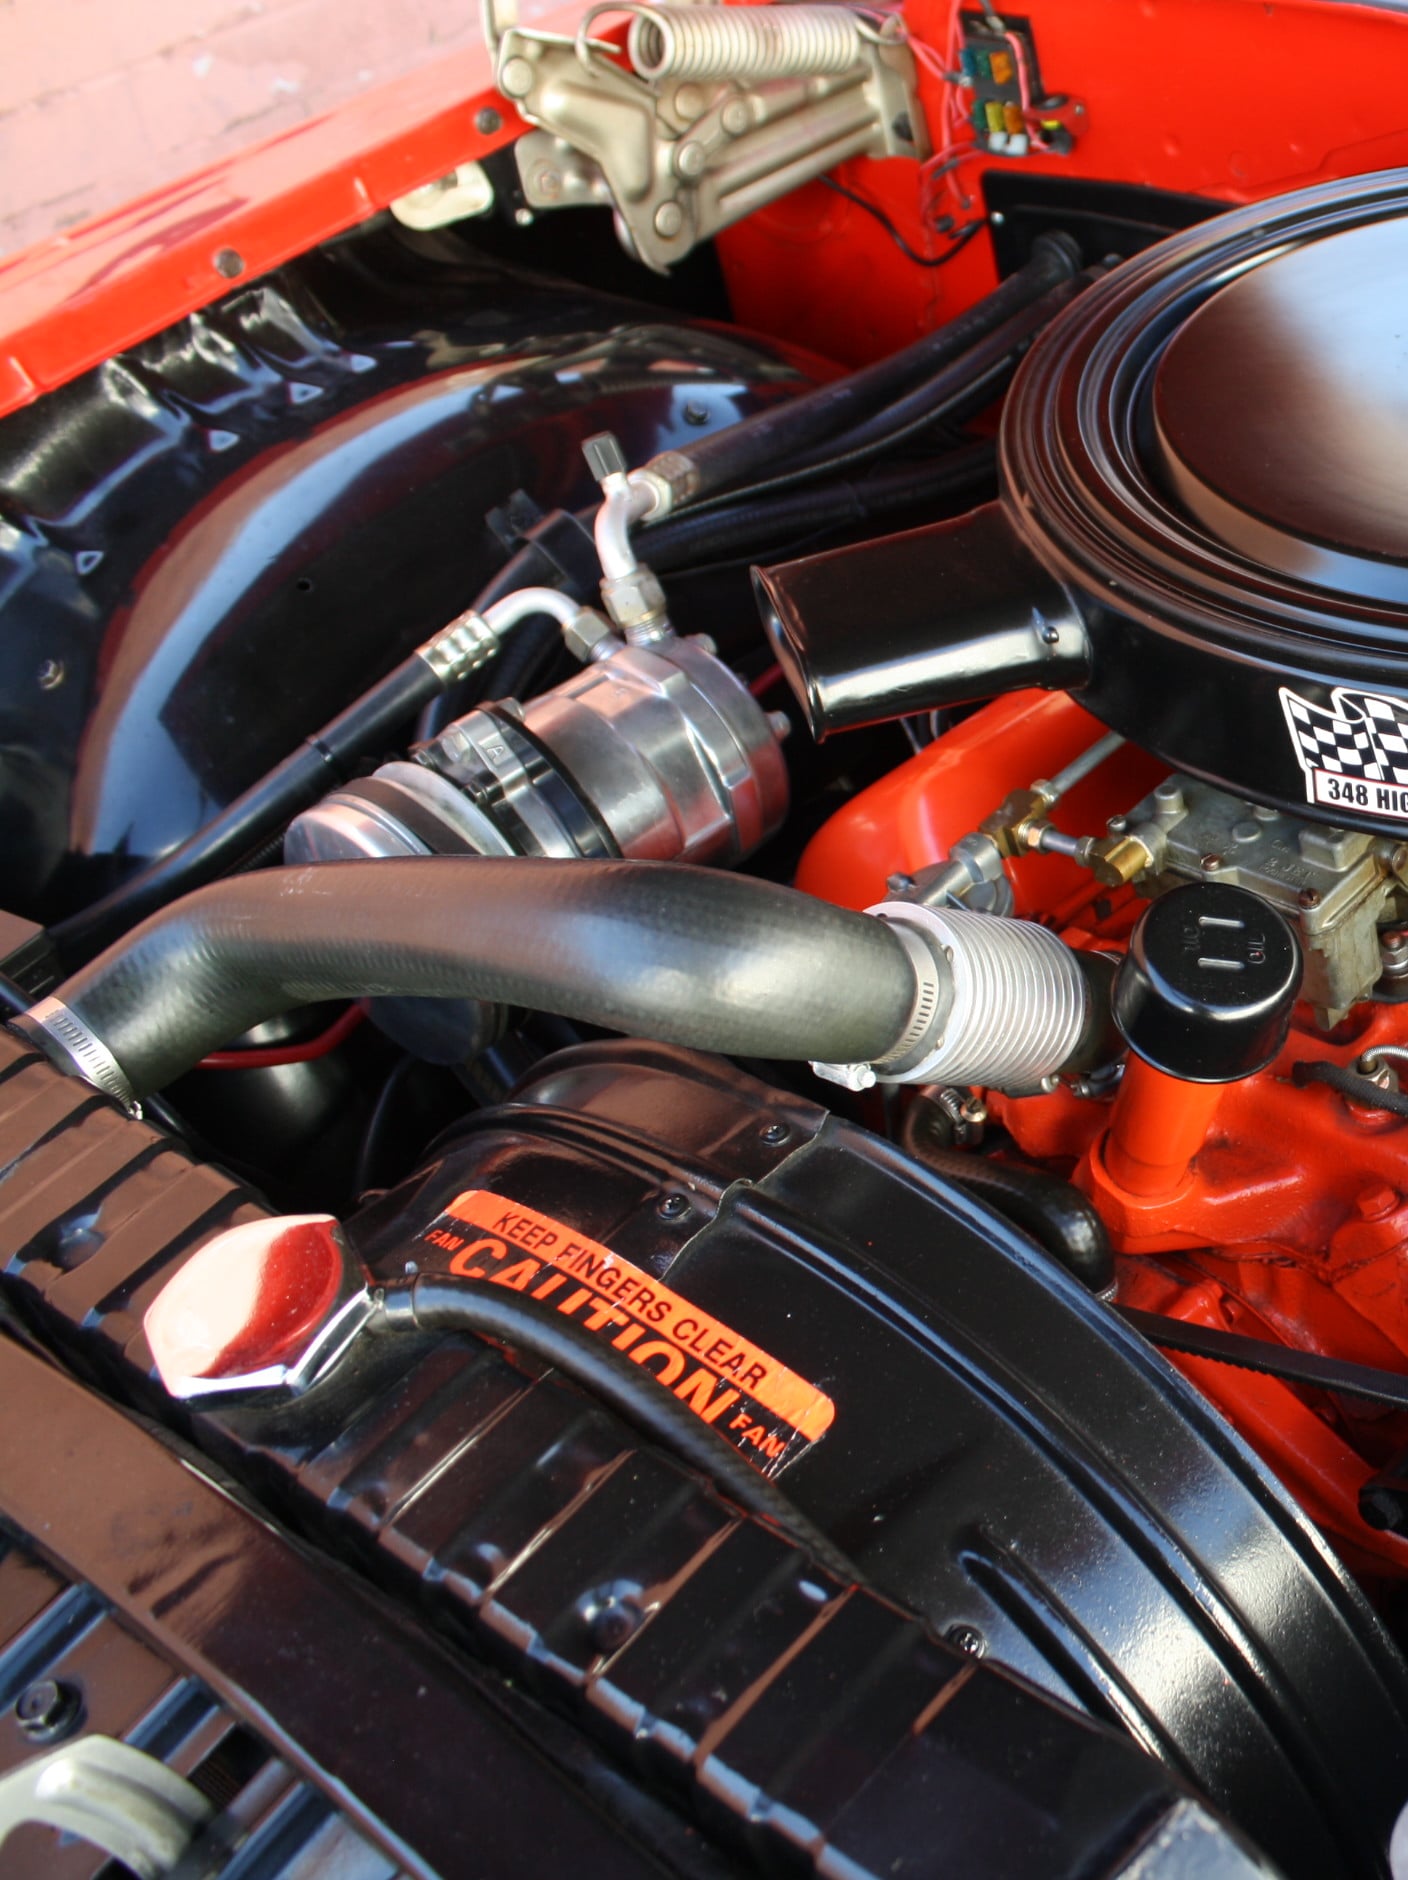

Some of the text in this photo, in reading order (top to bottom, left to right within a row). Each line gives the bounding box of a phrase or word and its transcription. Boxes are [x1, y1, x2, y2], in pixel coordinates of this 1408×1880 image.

[1328, 777, 1369, 806] 348
[424, 1227, 464, 1251] FAN
[493, 1210, 768, 1391] KEEP FINGERS CLEAR
[730, 1413, 786, 1458] FAN
